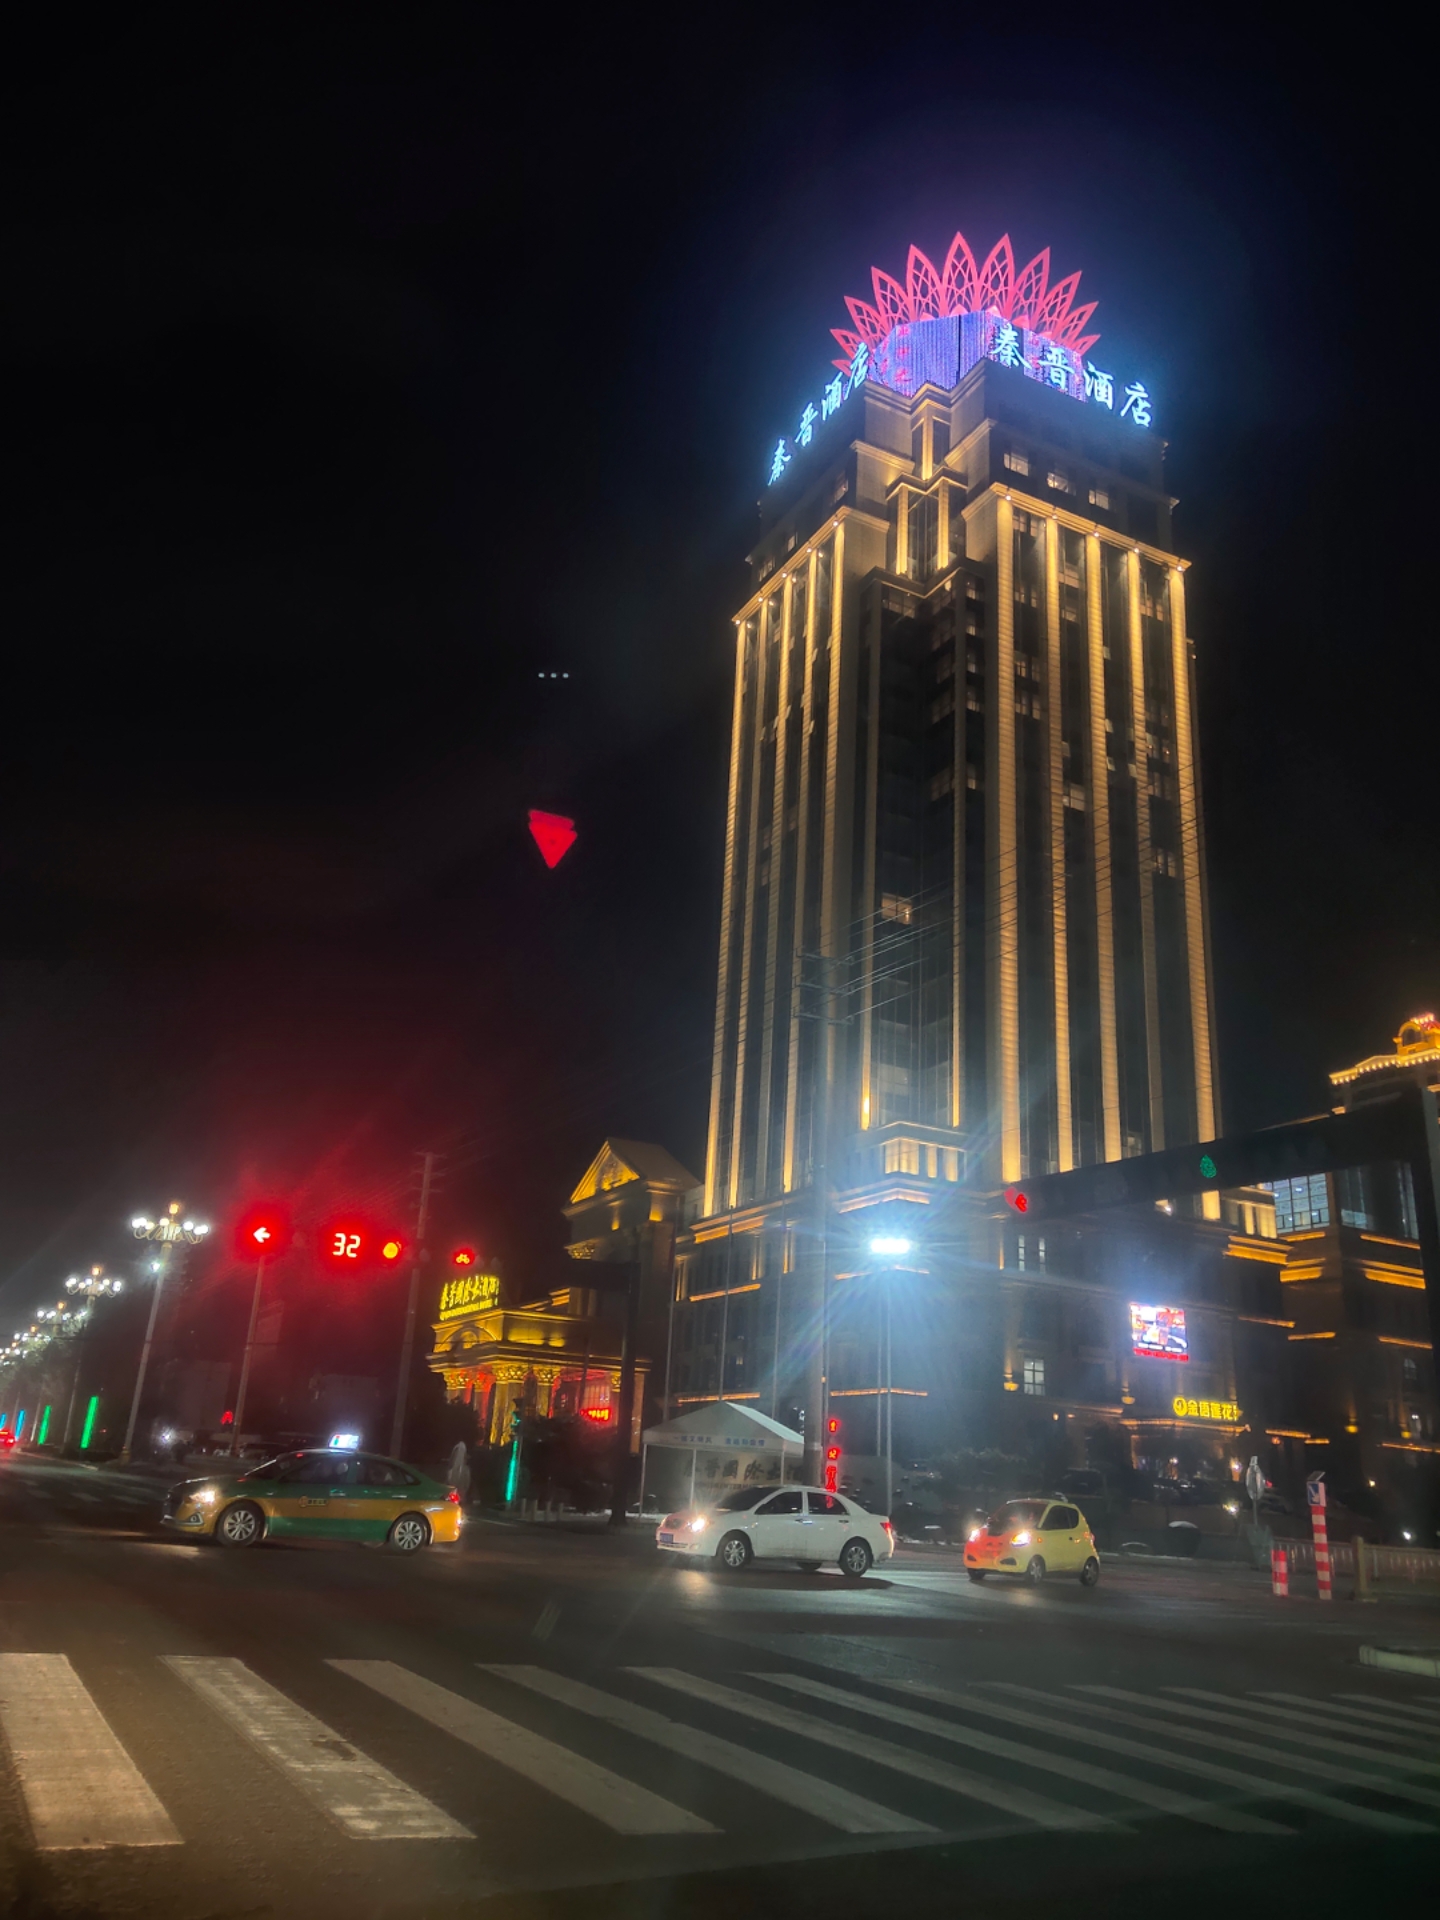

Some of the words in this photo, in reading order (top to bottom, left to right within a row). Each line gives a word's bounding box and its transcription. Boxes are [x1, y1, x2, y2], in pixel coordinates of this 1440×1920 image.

[768, 342, 869, 486] 秦晋酒店
[989, 322, 1152, 427] 秦晋酒店
[332, 1232, 361, 1258] 32
